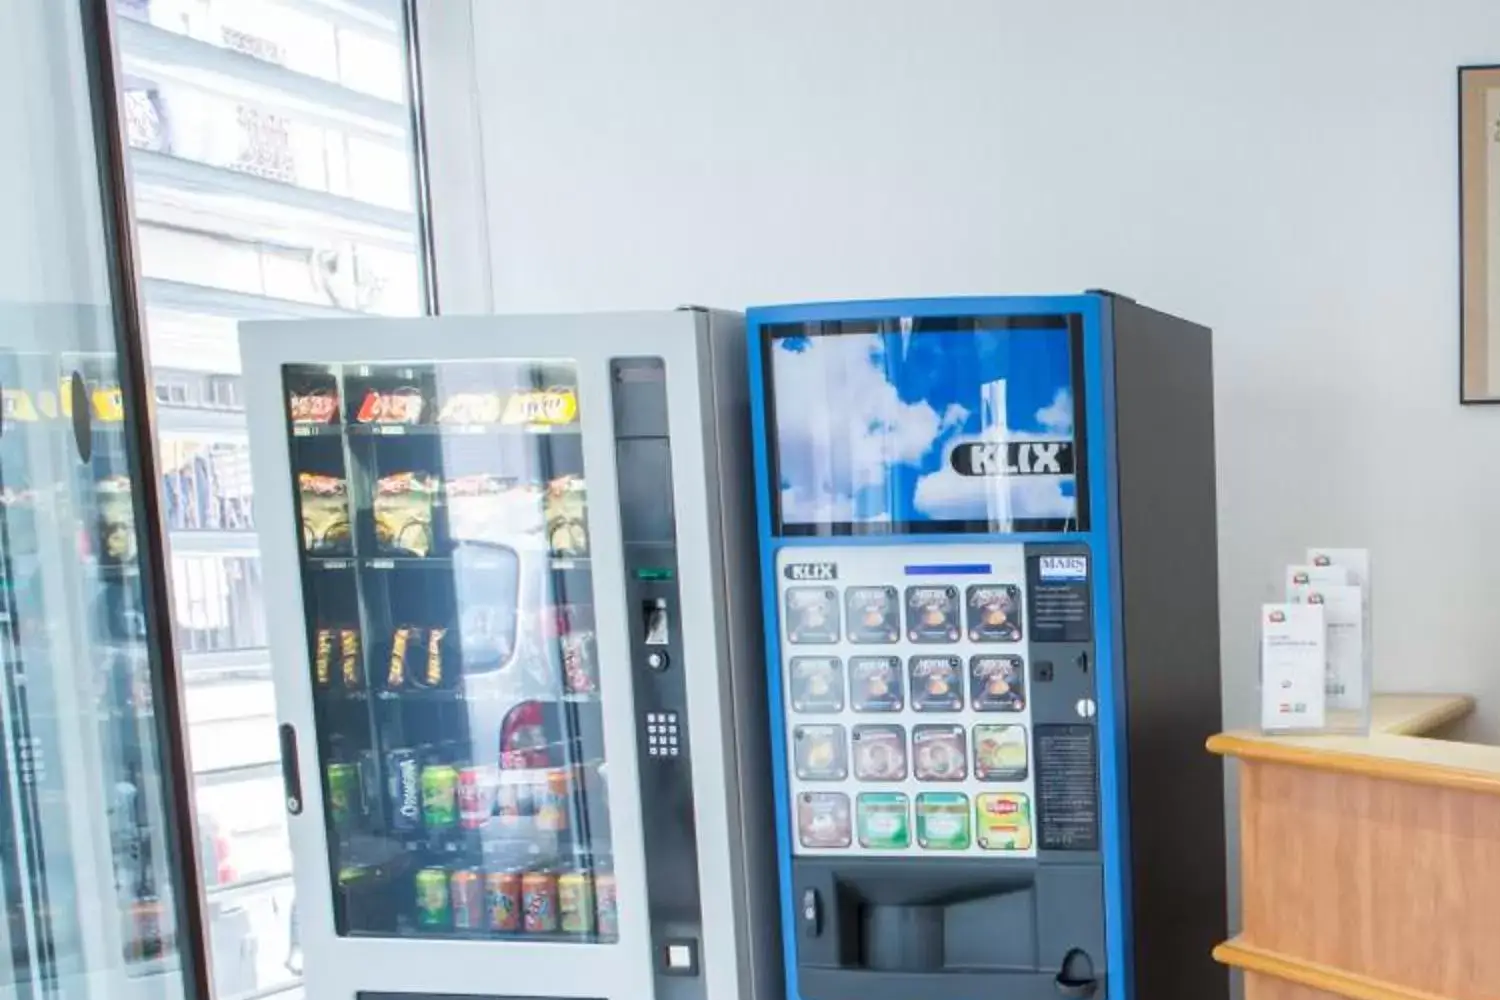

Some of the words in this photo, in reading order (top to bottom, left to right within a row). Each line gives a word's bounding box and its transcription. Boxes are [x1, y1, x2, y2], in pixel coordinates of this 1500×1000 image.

[971, 443, 1061, 474] KLIX
[793, 564, 834, 579] KLIX
[1041, 558, 1084, 570] MARS
